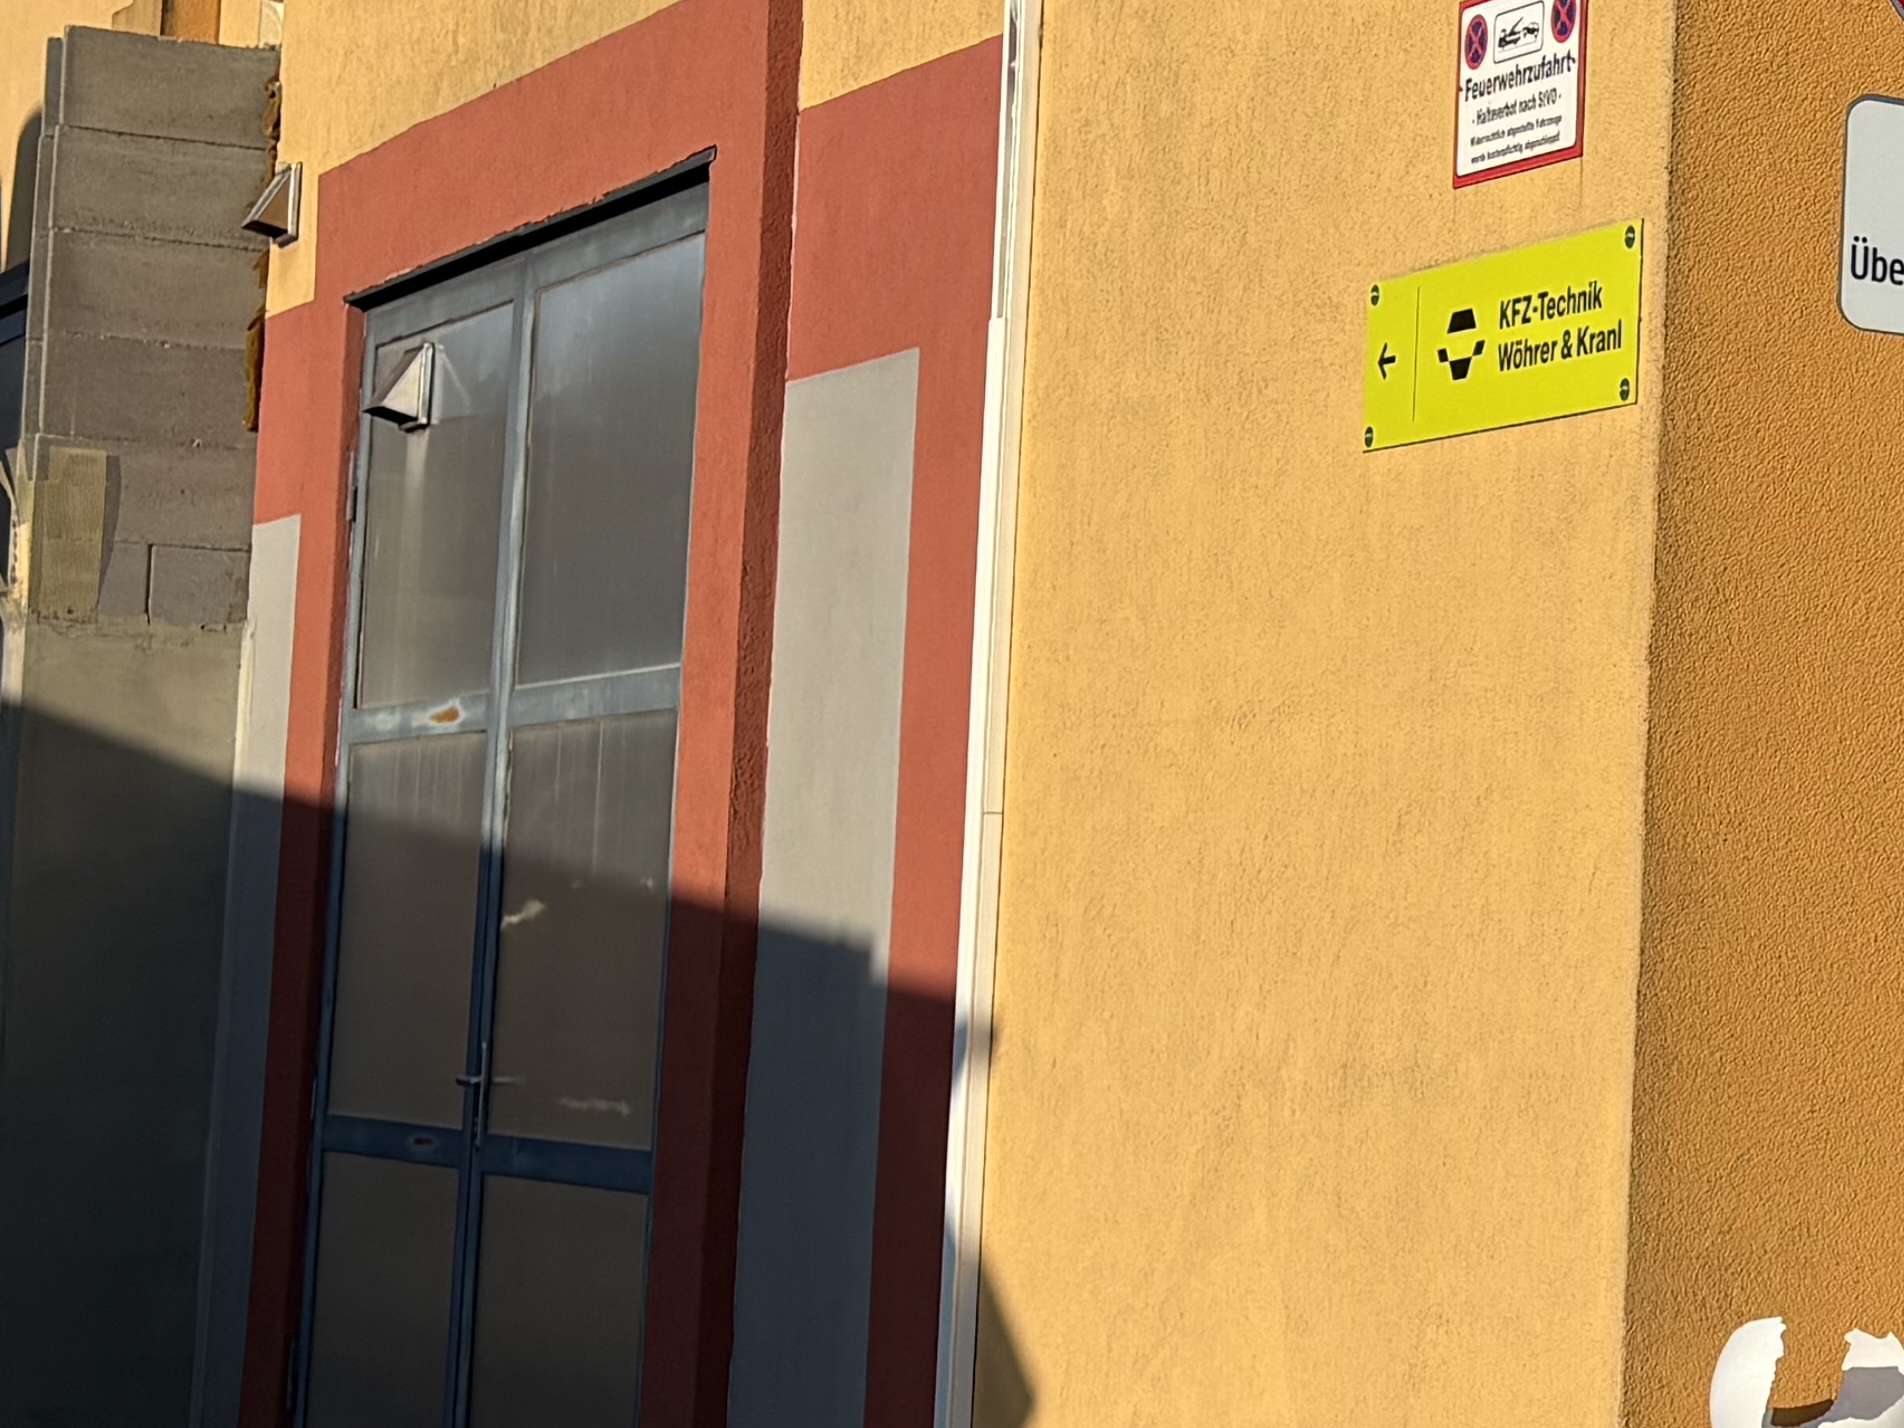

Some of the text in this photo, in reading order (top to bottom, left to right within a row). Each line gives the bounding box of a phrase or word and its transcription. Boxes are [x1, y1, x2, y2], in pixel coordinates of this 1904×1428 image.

[1464, 48, 1572, 102] Feuerwehrzufahrt
[1499, 280, 1603, 329] KFZ-Technik
[1498, 318, 1622, 372] Wöhrer & Kranl
